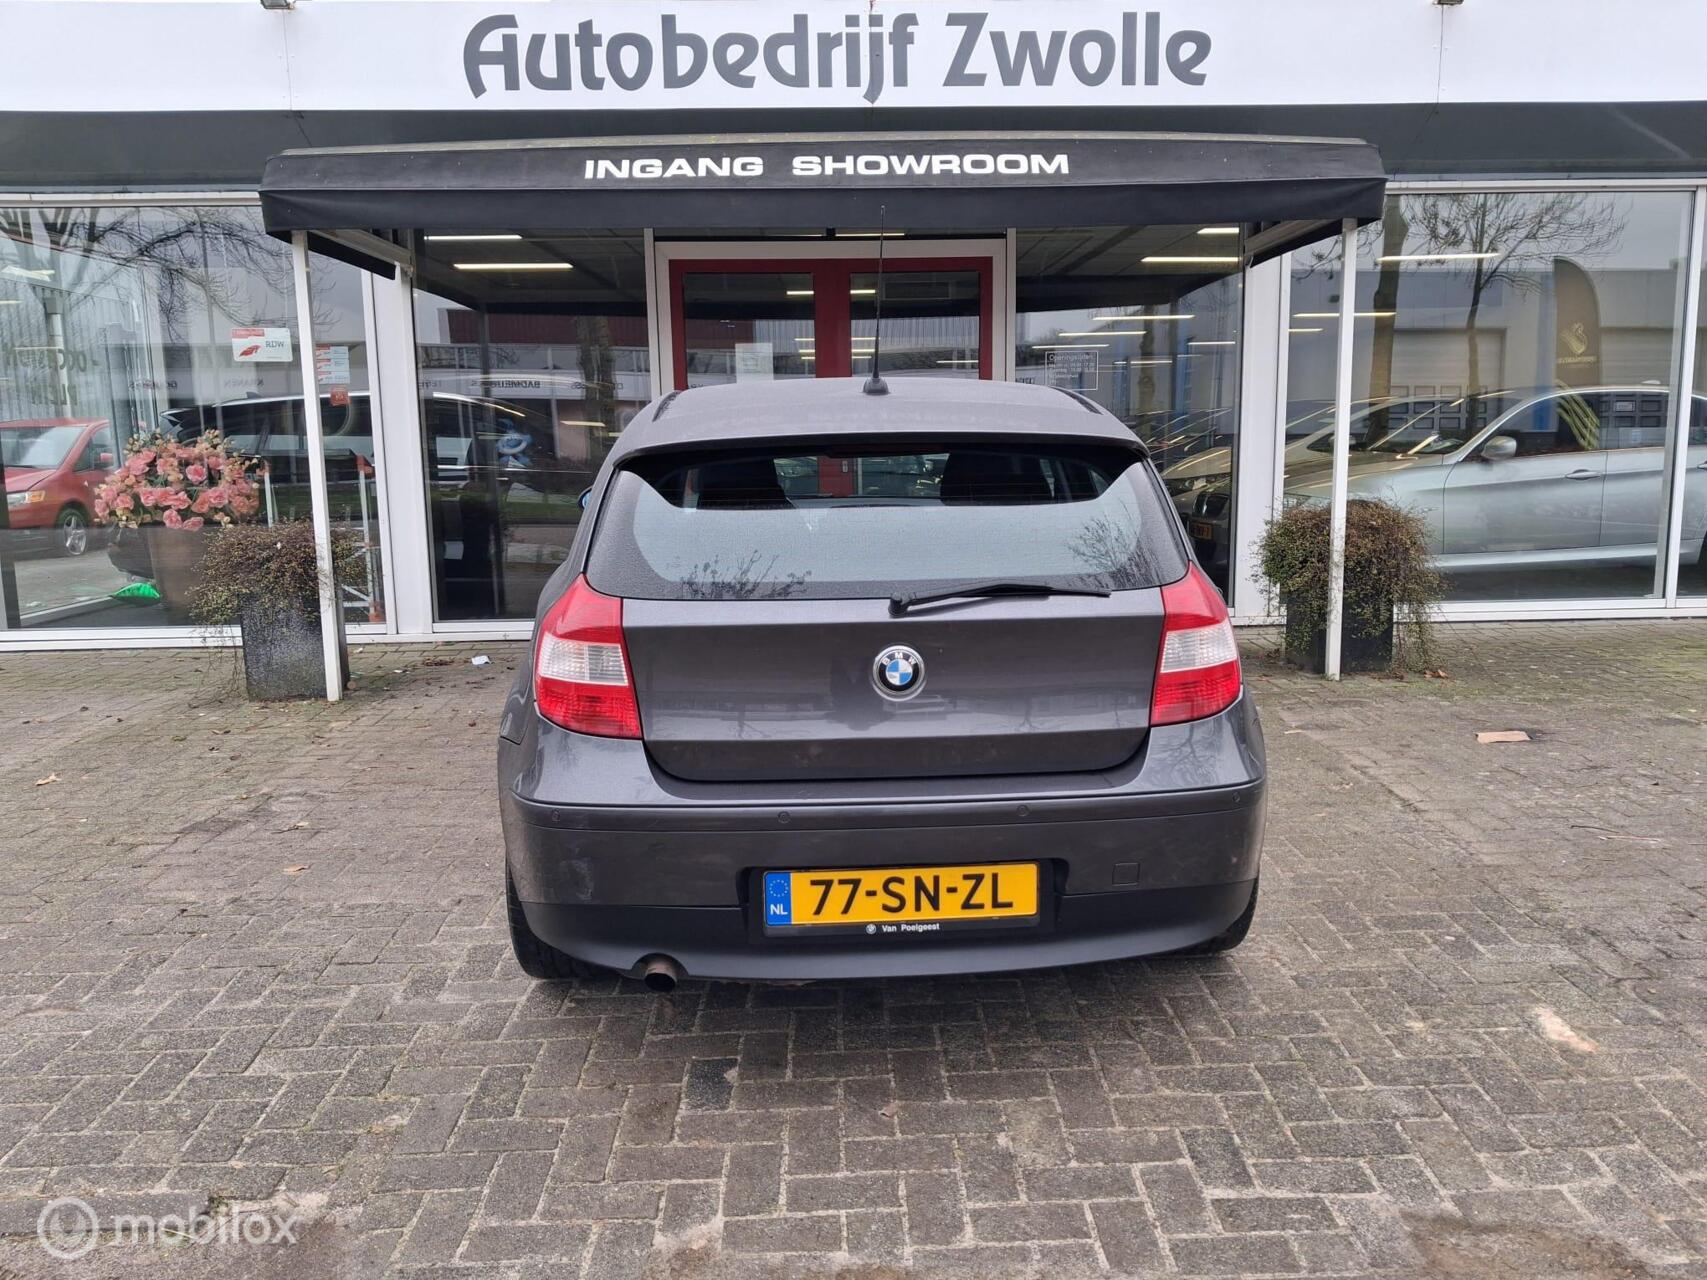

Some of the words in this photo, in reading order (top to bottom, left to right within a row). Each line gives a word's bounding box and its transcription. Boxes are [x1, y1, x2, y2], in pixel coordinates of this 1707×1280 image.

[463, 13, 919, 105] Autobedrijf
[942, 11, 1212, 87] Zwolle
[584, 155, 764, 180] INGANG
[791, 153, 1070, 176] SHOWROOM
[265, 340, 285, 349] RDW
[880, 652, 918, 666] BMW
[809, 872, 1014, 916] 77-SN-ZL
[769, 903, 788, 916] NL
[882, 924, 897, 932] Van
[901, 923, 940, 932] Poelgeest
